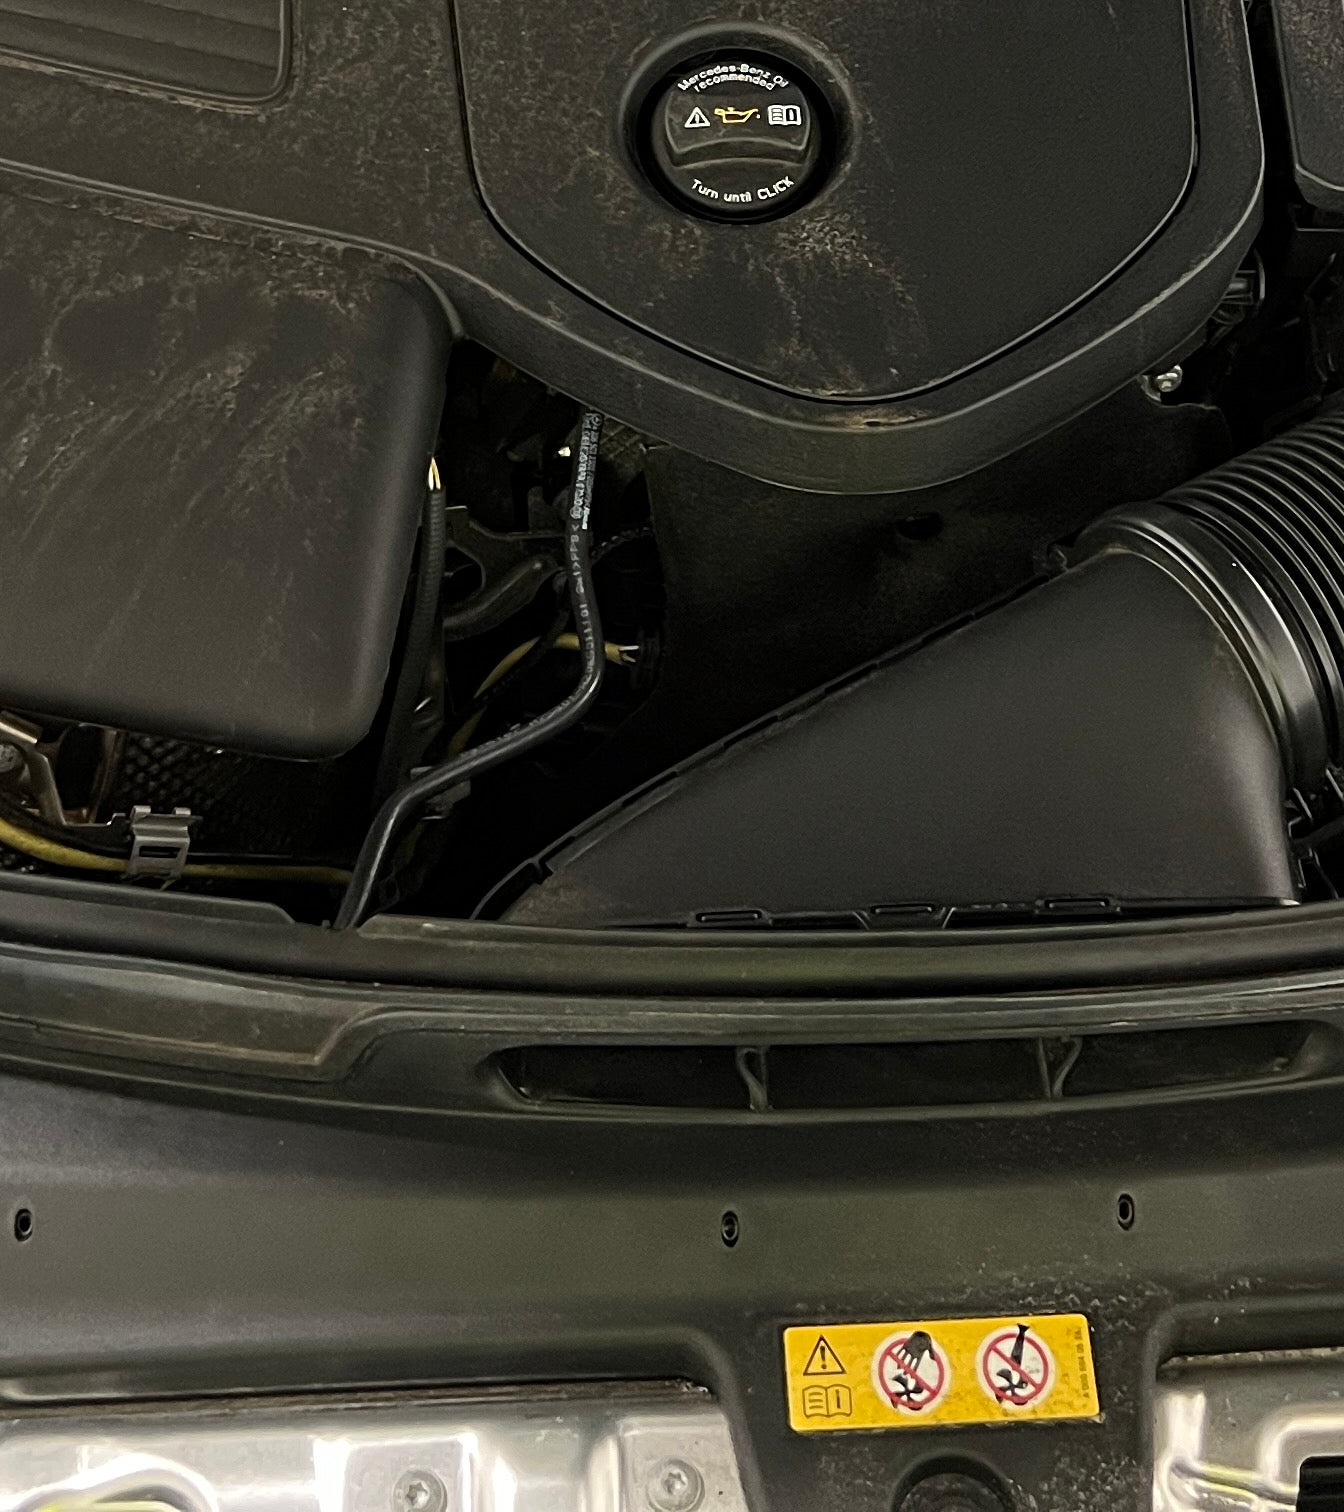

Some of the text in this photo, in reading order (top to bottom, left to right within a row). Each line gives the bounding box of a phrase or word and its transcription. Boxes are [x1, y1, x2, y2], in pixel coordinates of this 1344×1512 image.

[677, 63, 789, 91] Mercedes-Benz Oil
[693, 73, 776, 93] recommended
[691, 175, 795, 203] Turn until CLICK
